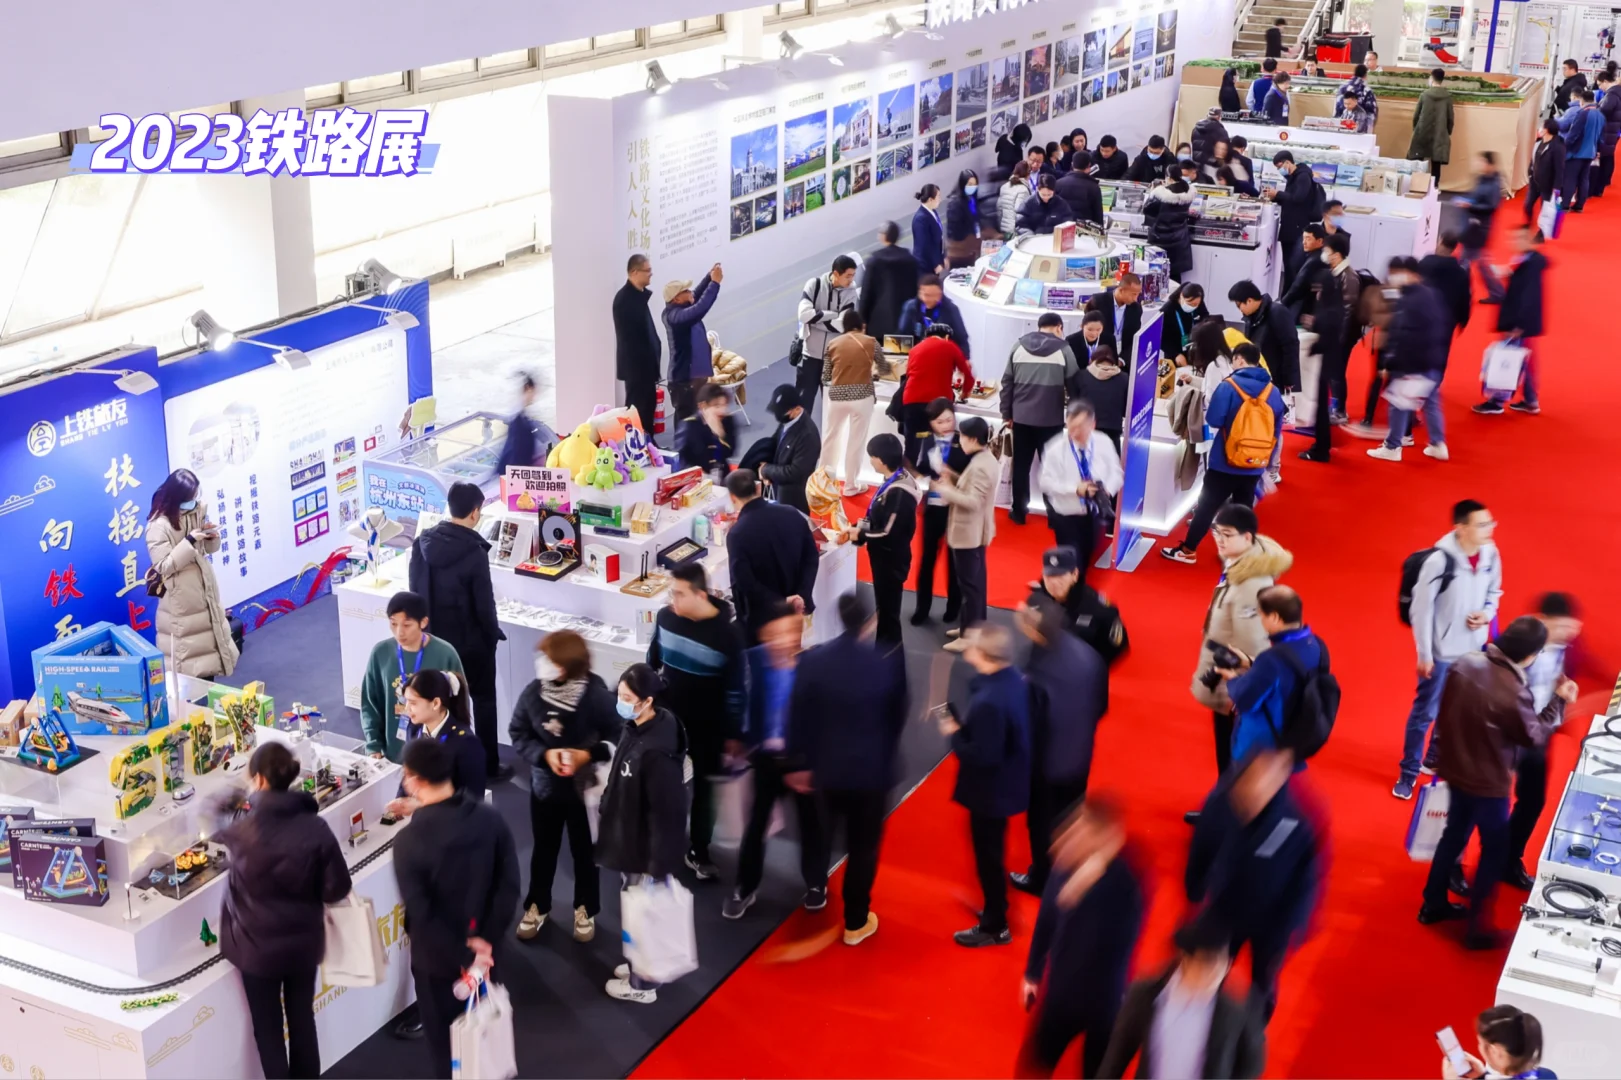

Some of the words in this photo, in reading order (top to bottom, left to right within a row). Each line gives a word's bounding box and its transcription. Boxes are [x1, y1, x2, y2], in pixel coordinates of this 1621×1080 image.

[639, 138, 652, 258] 铁路文化场
[510, 469, 552, 481] 天团驾到
[525, 480, 567, 492] 欢迎拍照
[369, 487, 425, 513] 杭州东站
[103, 454, 151, 631] 扶摇直上
